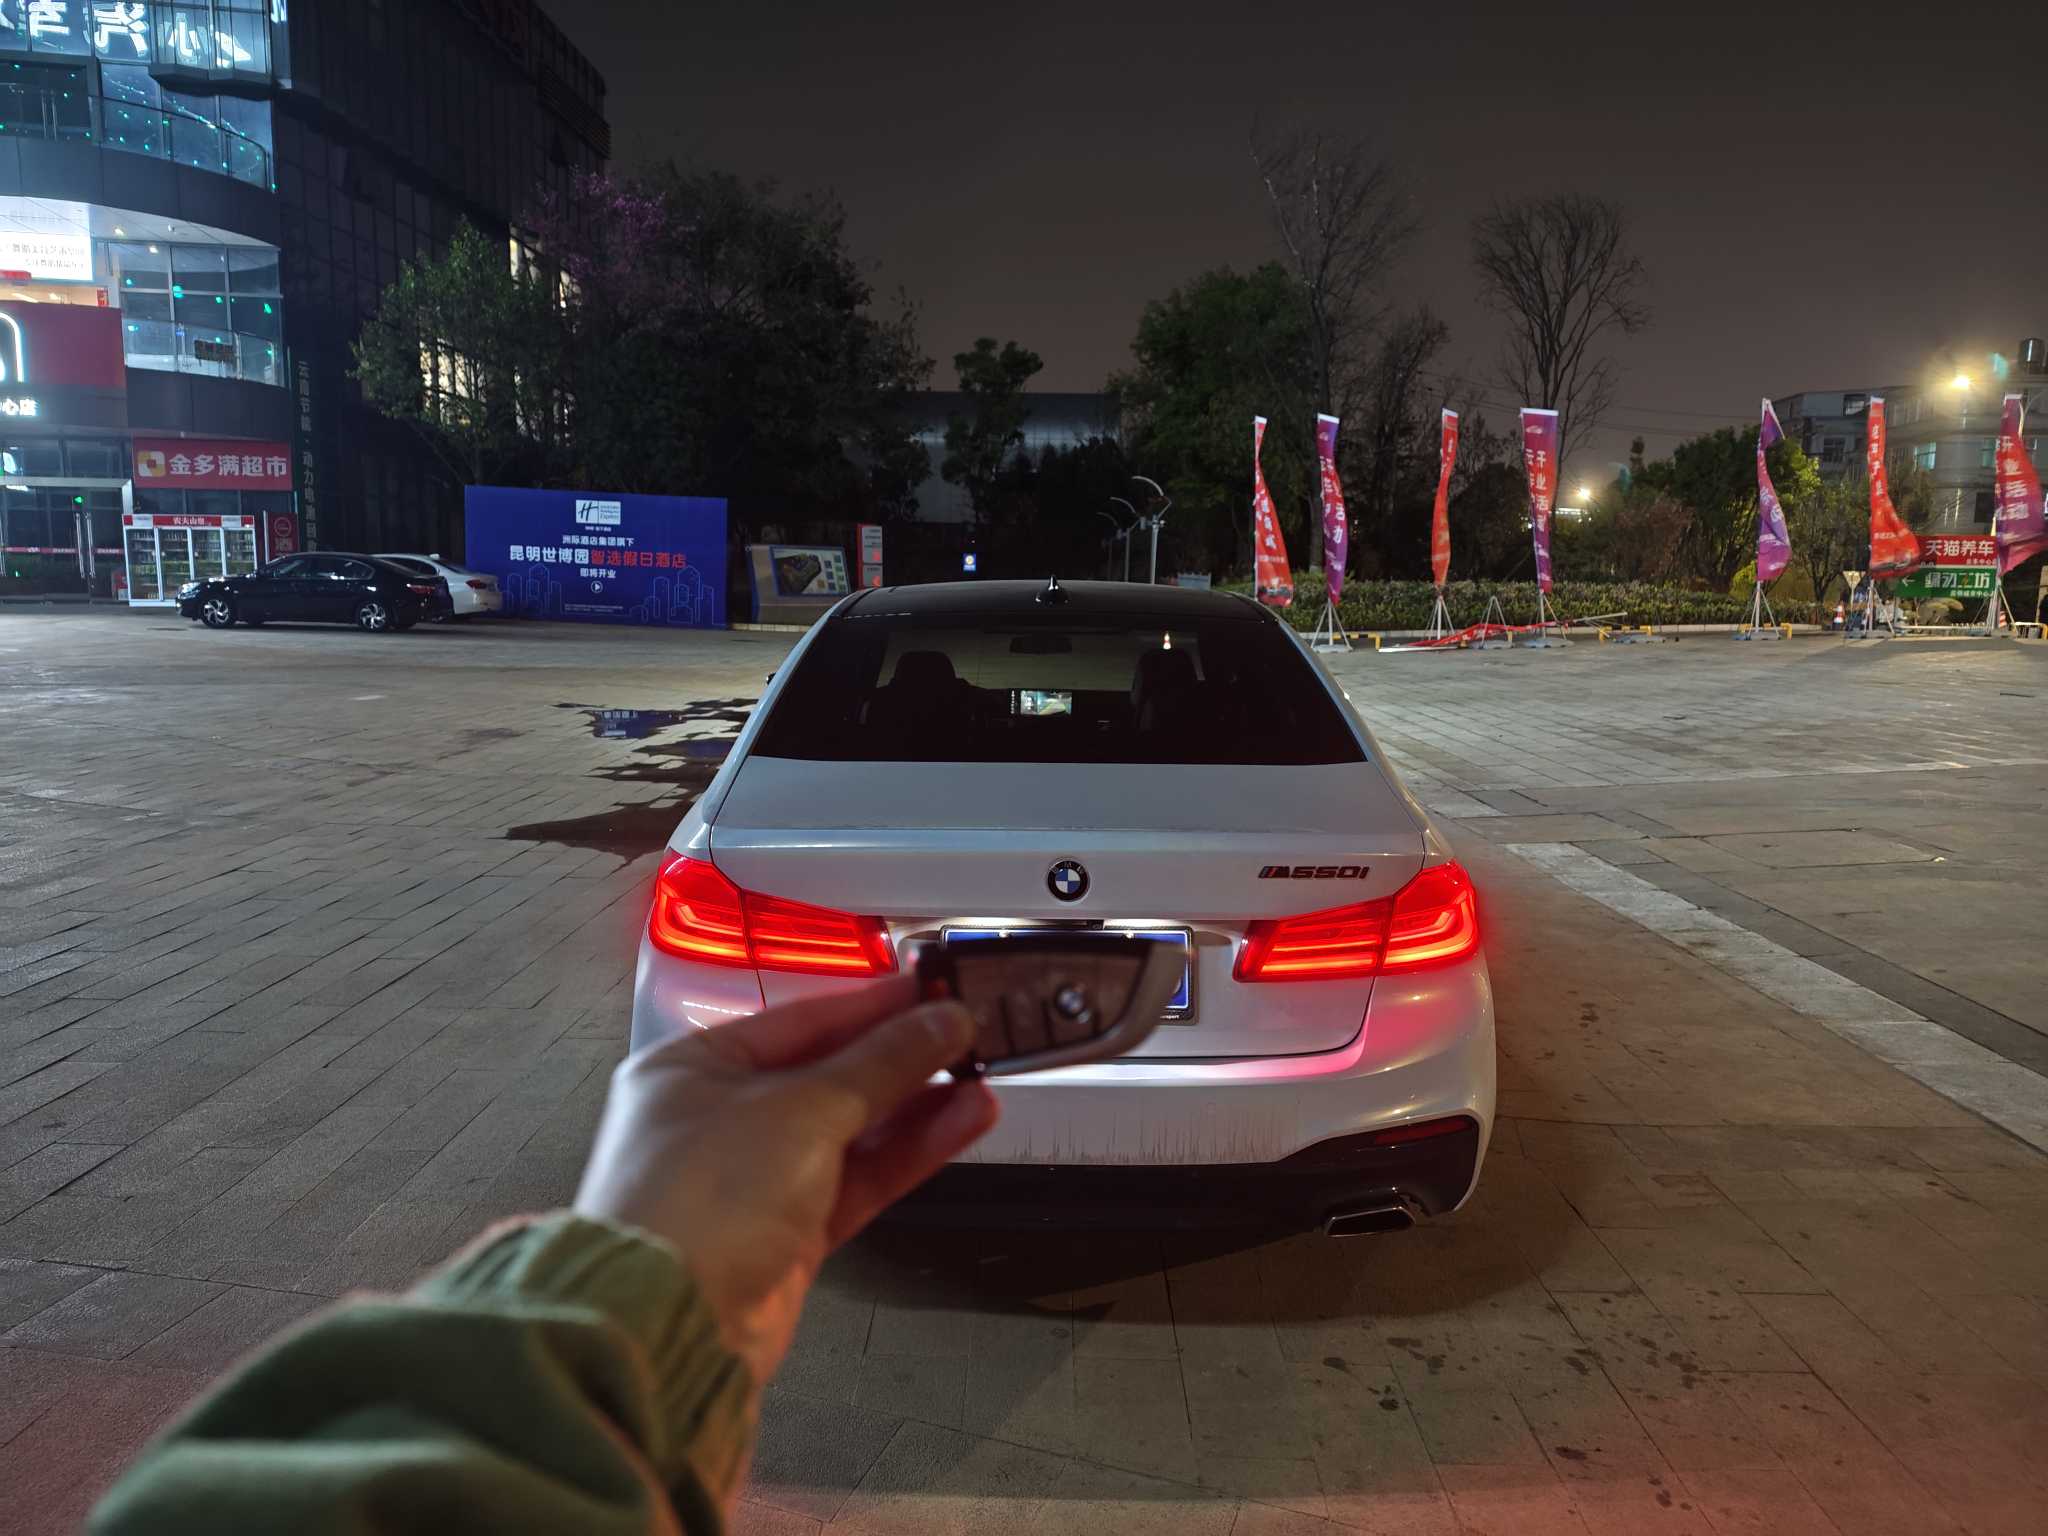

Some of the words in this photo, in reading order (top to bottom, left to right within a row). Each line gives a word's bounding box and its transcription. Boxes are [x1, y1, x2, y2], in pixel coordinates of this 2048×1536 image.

[168, 454, 287, 478] 金多满超市
[562, 535, 635, 547] 洲际酒店集团旗下
[1925, 540, 1994, 557] 天猫养车
[580, 568, 617, 579] 即将开业
